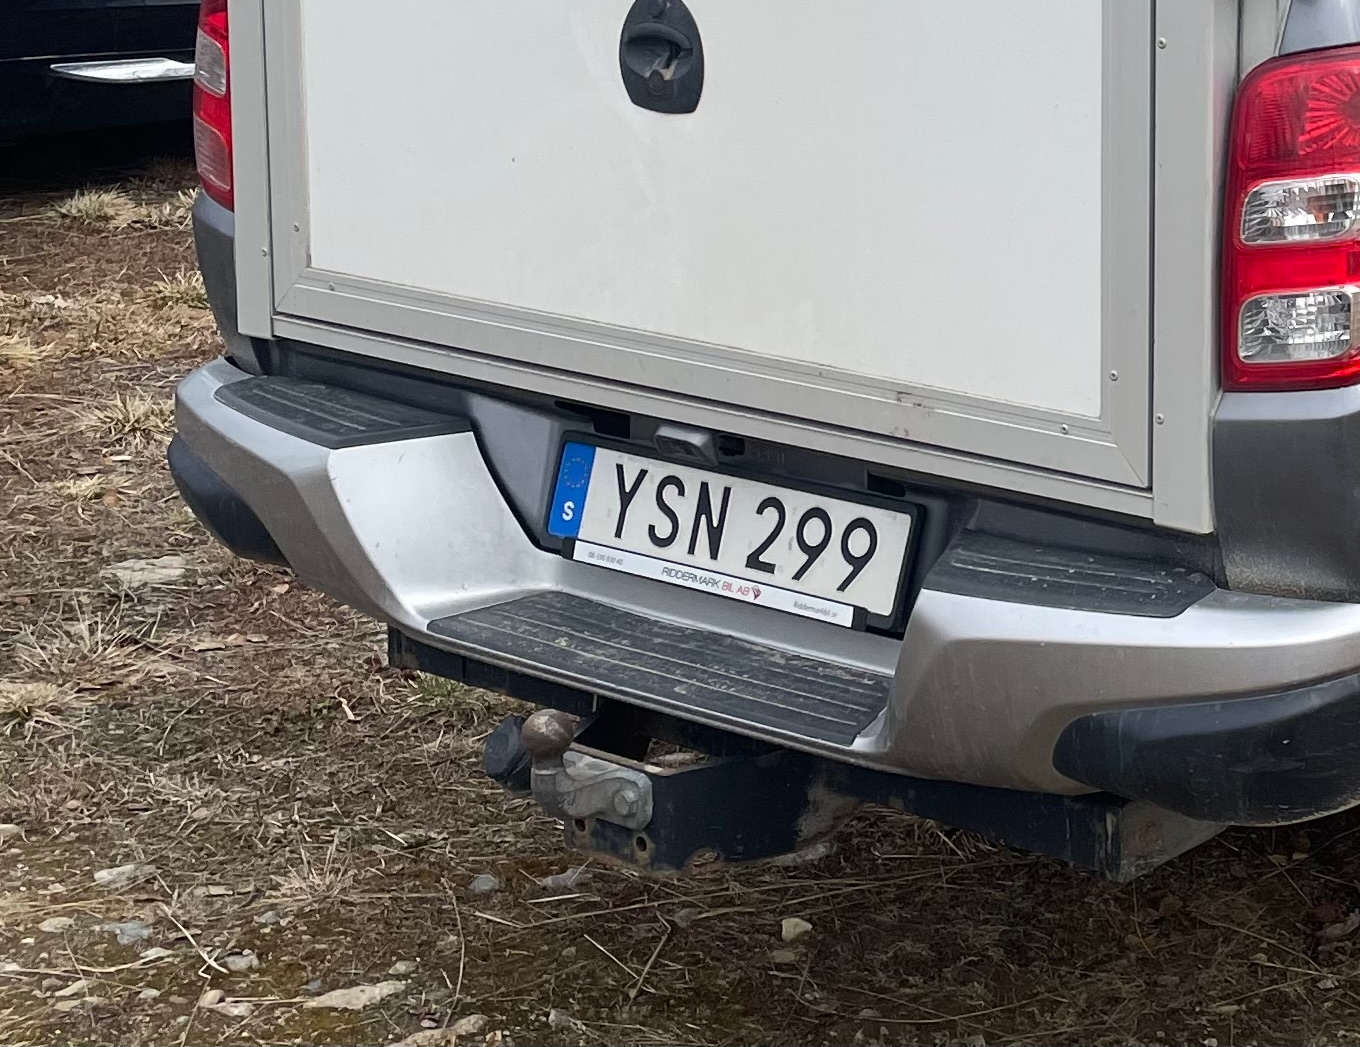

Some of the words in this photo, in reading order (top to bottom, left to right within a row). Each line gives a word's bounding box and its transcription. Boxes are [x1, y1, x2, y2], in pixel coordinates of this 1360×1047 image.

[562, 500, 576, 521] S
[614, 463, 732, 560] YSN
[745, 496, 878, 592] 299
[661, 566, 721, 589] RIDDERMARK
[721, 581, 734, 593] BIL
[736, 585, 750, 596] AB
